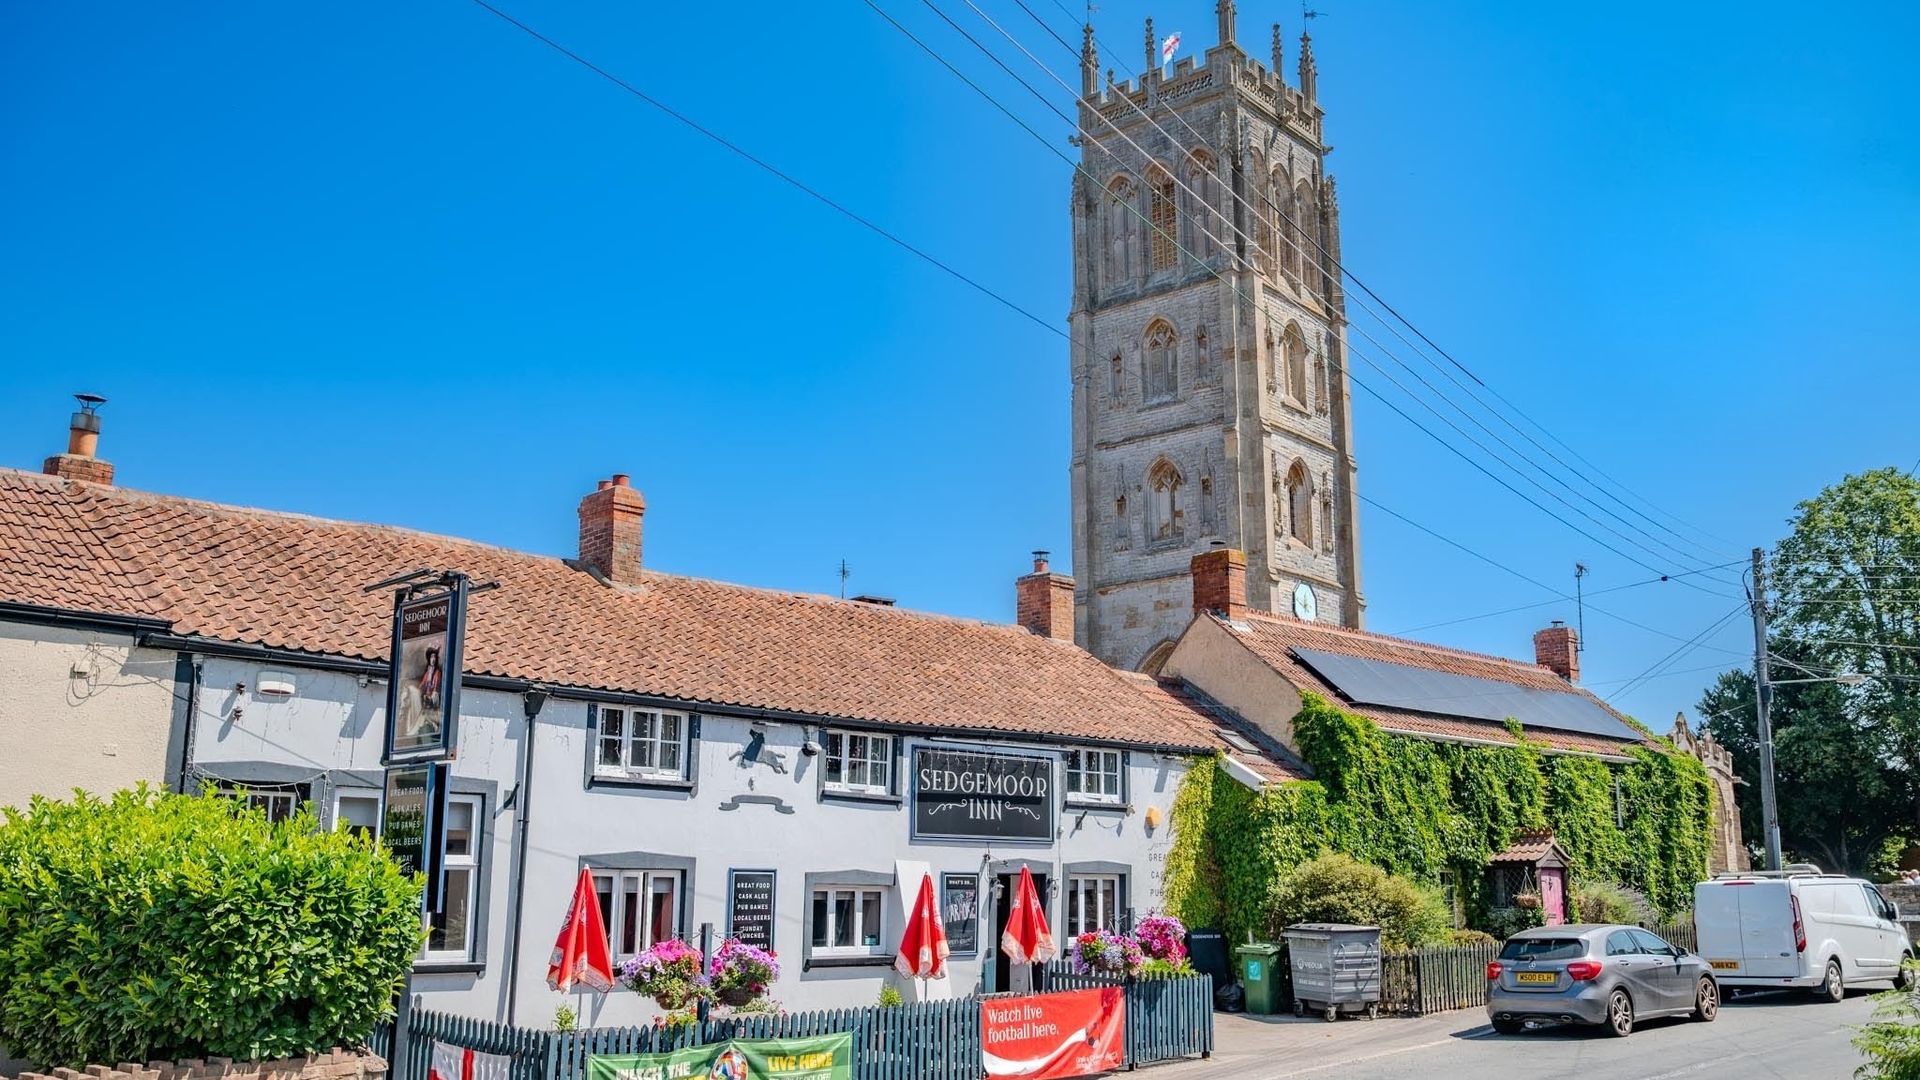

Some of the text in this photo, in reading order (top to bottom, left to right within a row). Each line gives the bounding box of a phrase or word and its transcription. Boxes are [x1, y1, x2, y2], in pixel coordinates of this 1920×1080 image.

[404, 606, 447, 623] SEDGEMOOR
[419, 622, 431, 632] INN
[920, 768, 1047, 797] SEDGEMOOR
[390, 787, 424, 797] GREAT FOOD
[406, 803, 421, 812] ALES
[969, 798, 1002, 821] INN
[388, 820, 421, 830] PUB GAMES
[403, 837, 422, 846] BEERS
[1537, 974, 1552, 982] ELH
[988, 1005, 1043, 1025] Watch live
[988, 1024, 1060, 1043] football here.
[666, 1061, 691, 1079] THE
[768, 1052, 833, 1072] LIVE HERE
